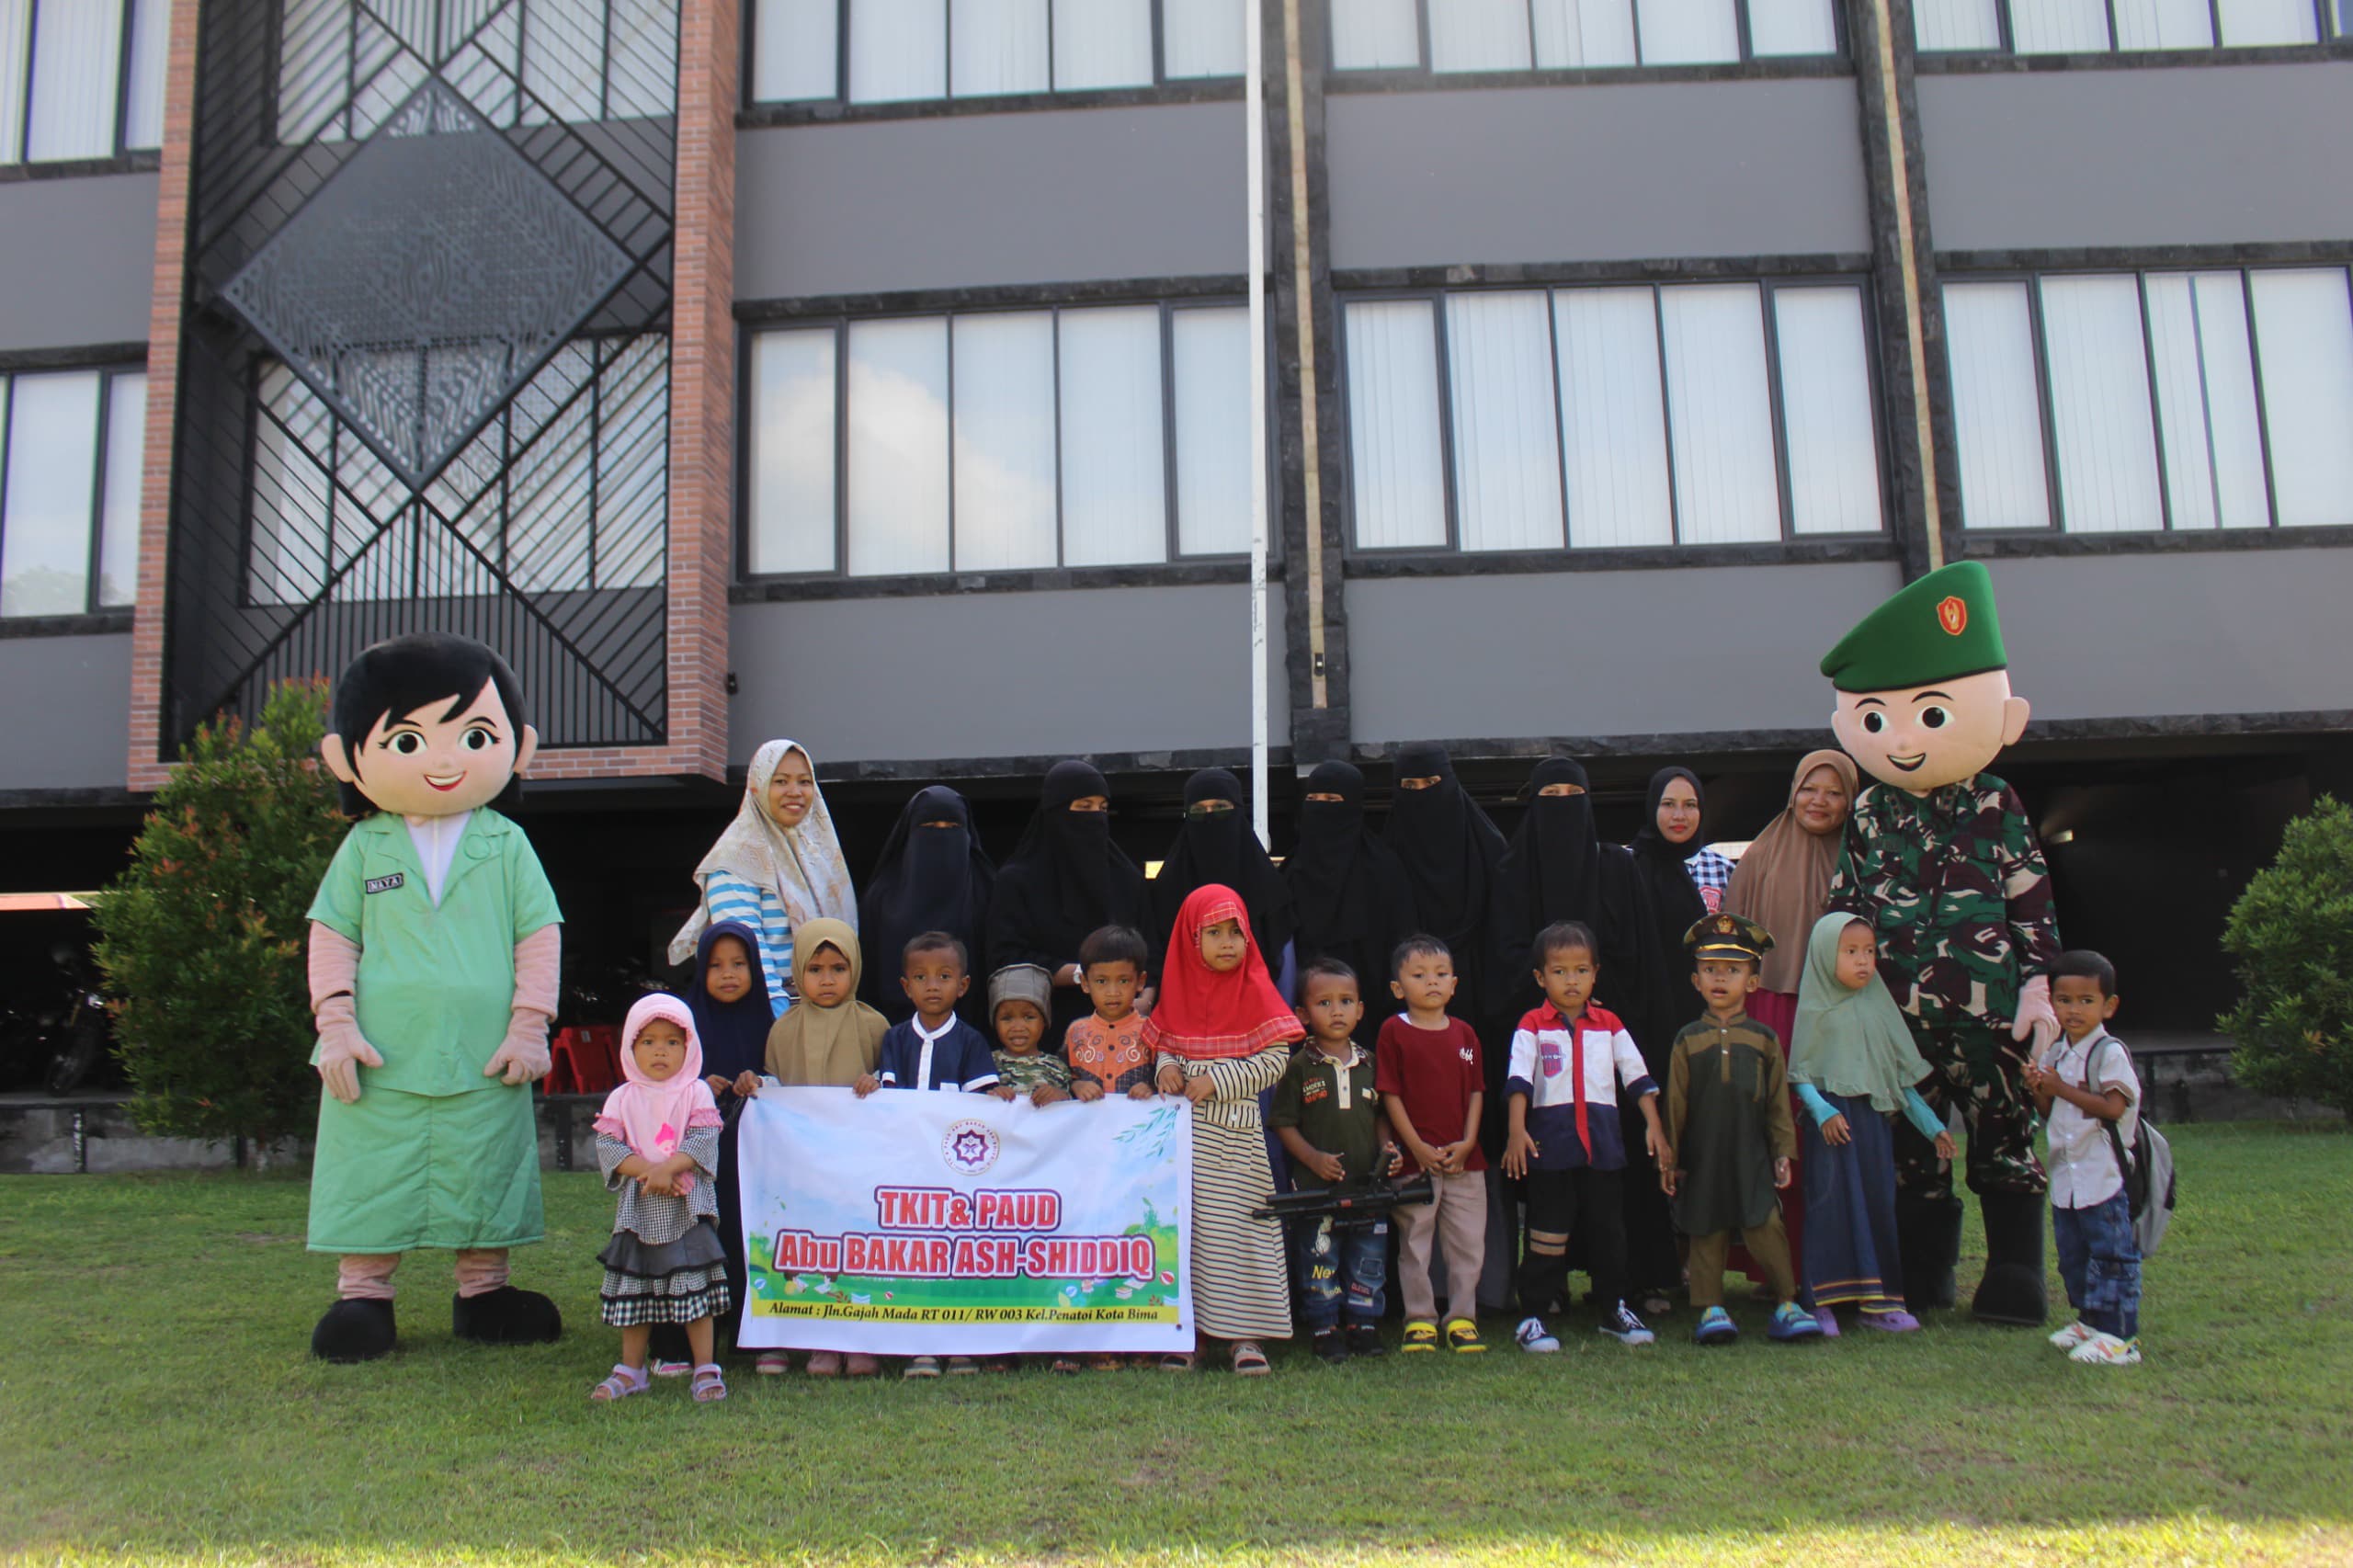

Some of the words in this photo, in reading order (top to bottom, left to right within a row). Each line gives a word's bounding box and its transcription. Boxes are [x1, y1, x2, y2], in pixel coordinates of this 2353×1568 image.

[977, 1194, 1056, 1226] PAUD
[778, 1233, 838, 1268] Abu
[845, 1237, 949, 1273] BAKAR
[954, 1240, 1151, 1276] ASH-SHIDDIQ
[769, 1301, 813, 1315] Alamat
[882, 1308, 917, 1320] Mada
[920, 1309, 938, 1320] RT
[975, 1309, 998, 1320] RW
[1000, 1309, 1022, 1320] 003
[1096, 1308, 1124, 1320] Kota
[1127, 1308, 1158, 1320] Bima
